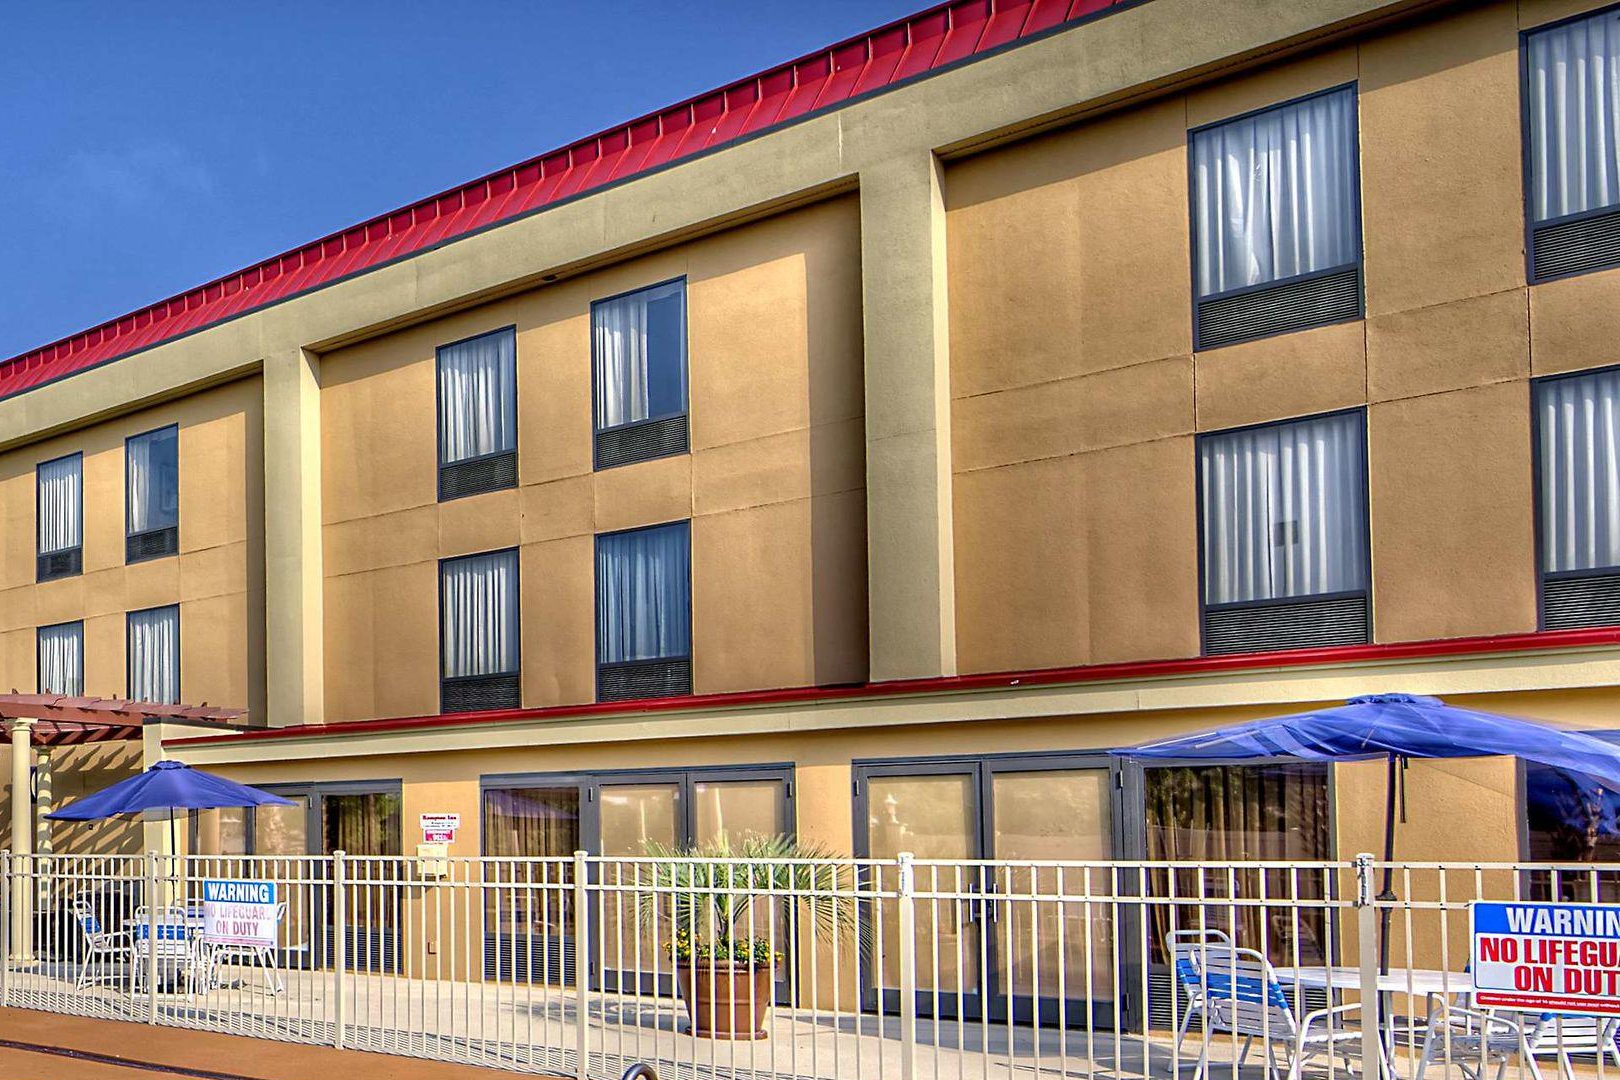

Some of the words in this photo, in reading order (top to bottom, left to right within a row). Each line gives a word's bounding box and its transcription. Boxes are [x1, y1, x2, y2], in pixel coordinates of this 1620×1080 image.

[207, 882, 270, 903] WARNING
[220, 904, 272, 920] LIFEGUAR
[216, 920, 229, 935] ON
[233, 921, 259, 936] DUTY
[1480, 937, 1519, 963] NO
[1523, 938, 1620, 968] LIFEGU
[1514, 965, 1553, 993] ON
